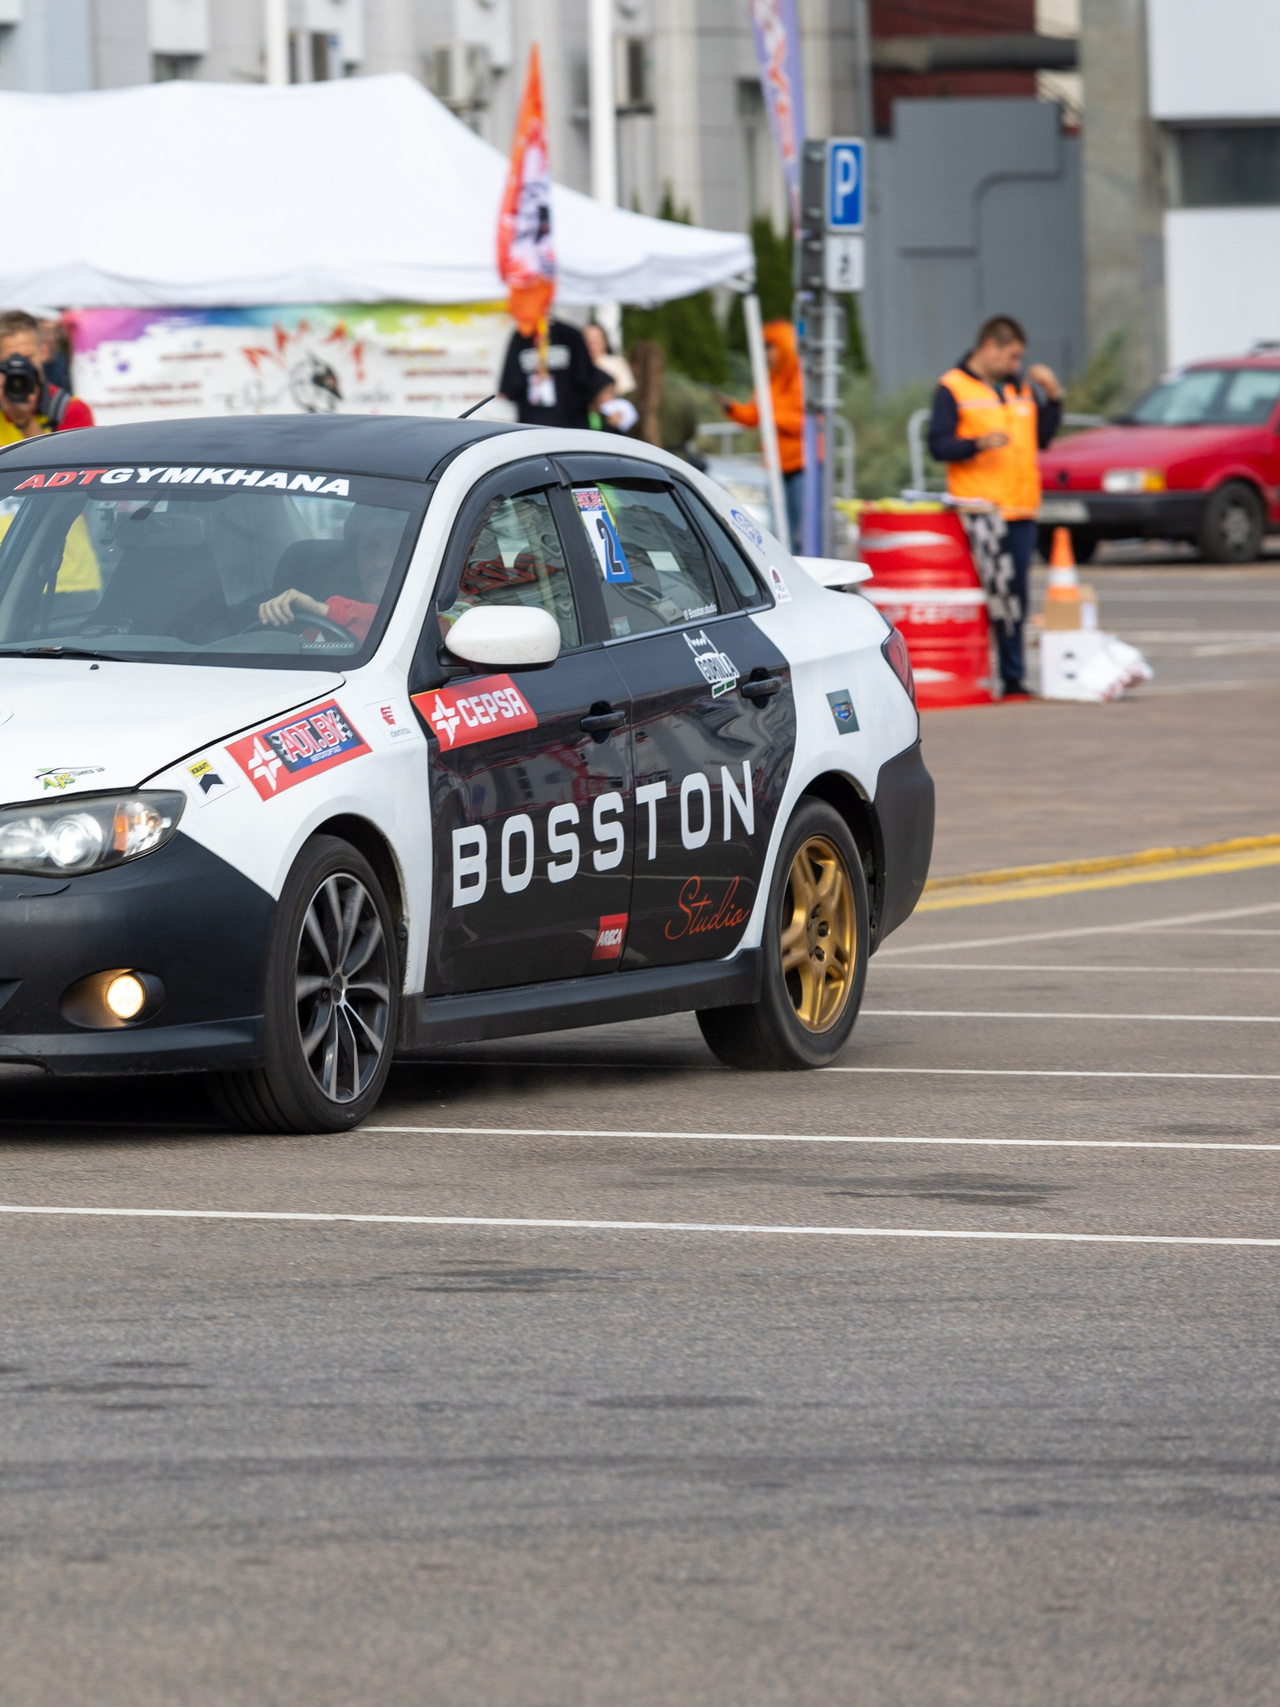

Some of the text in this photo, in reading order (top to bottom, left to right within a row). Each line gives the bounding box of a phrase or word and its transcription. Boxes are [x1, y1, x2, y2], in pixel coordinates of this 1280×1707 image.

[835, 148, 857, 219] P
[13, 467, 351, 497] ADTGYMKHANA
[596, 518, 625, 574] 2
[455, 687, 528, 728] CEPSA
[452, 759, 755, 908] BOSSTON
[664, 875, 751, 940] Studio
